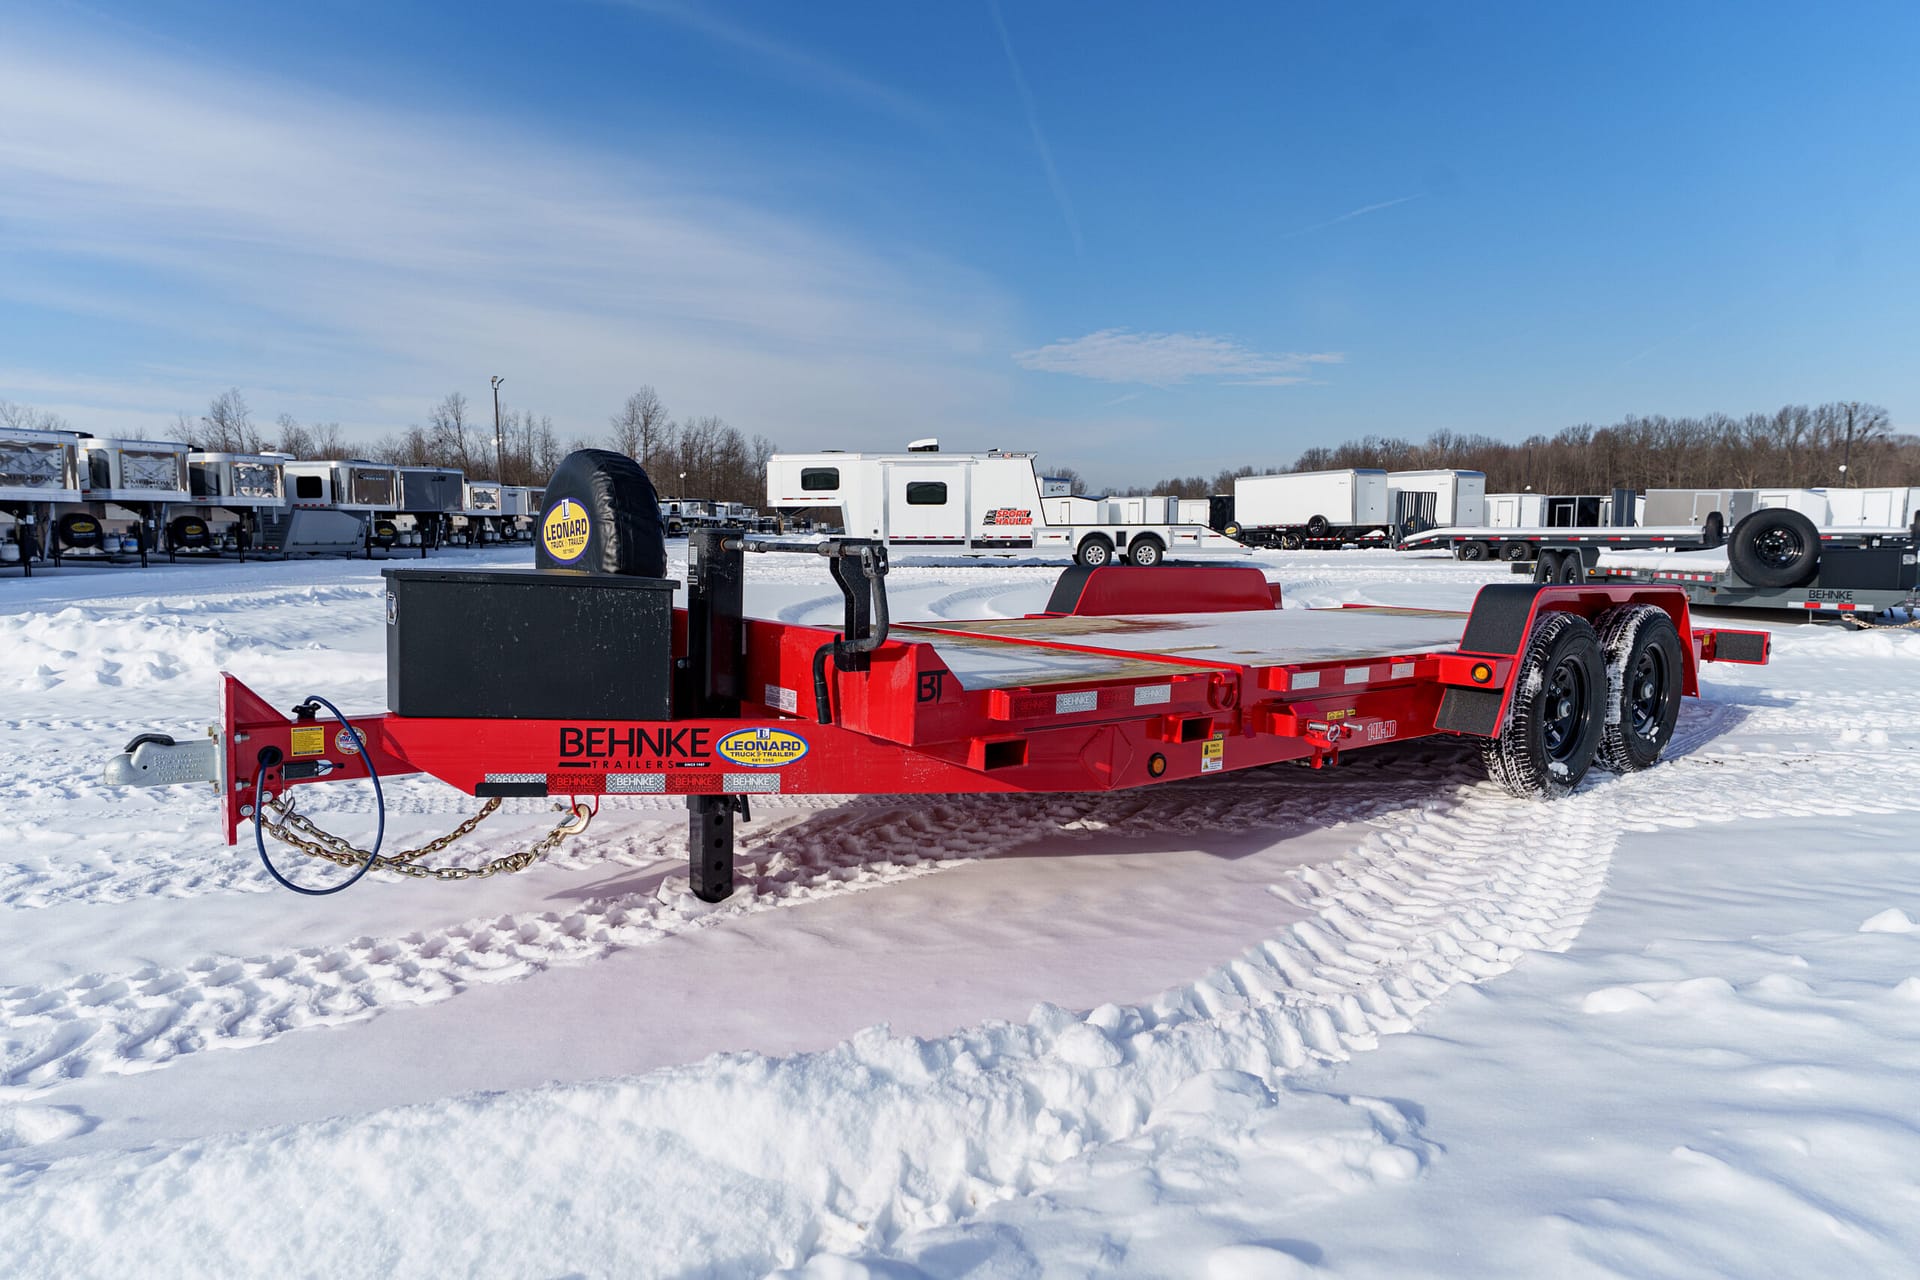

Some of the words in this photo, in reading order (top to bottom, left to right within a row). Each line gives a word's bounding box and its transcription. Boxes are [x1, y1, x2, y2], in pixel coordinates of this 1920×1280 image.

[996, 510, 1029, 518] SPORT
[995, 517, 1033, 526] HAULER
[545, 518, 587, 541] LEONARD
[550, 540, 564, 549] TRUCK
[567, 536, 585, 546] TRAILER
[1808, 589, 1853, 600] BEHNKE
[917, 669, 948, 704] BT
[1063, 695, 1090, 706] BEHNKE
[560, 727, 711, 758] BEHNKE
[725, 740, 801, 751] LEONARD
[592, 760, 674, 769] TRAILERS
[556, 777, 596, 786] BEHNKE
[616, 777, 656, 786] BEHNKE
[675, 777, 712, 786] BEHNKE
[732, 777, 770, 786] BEHNKE
